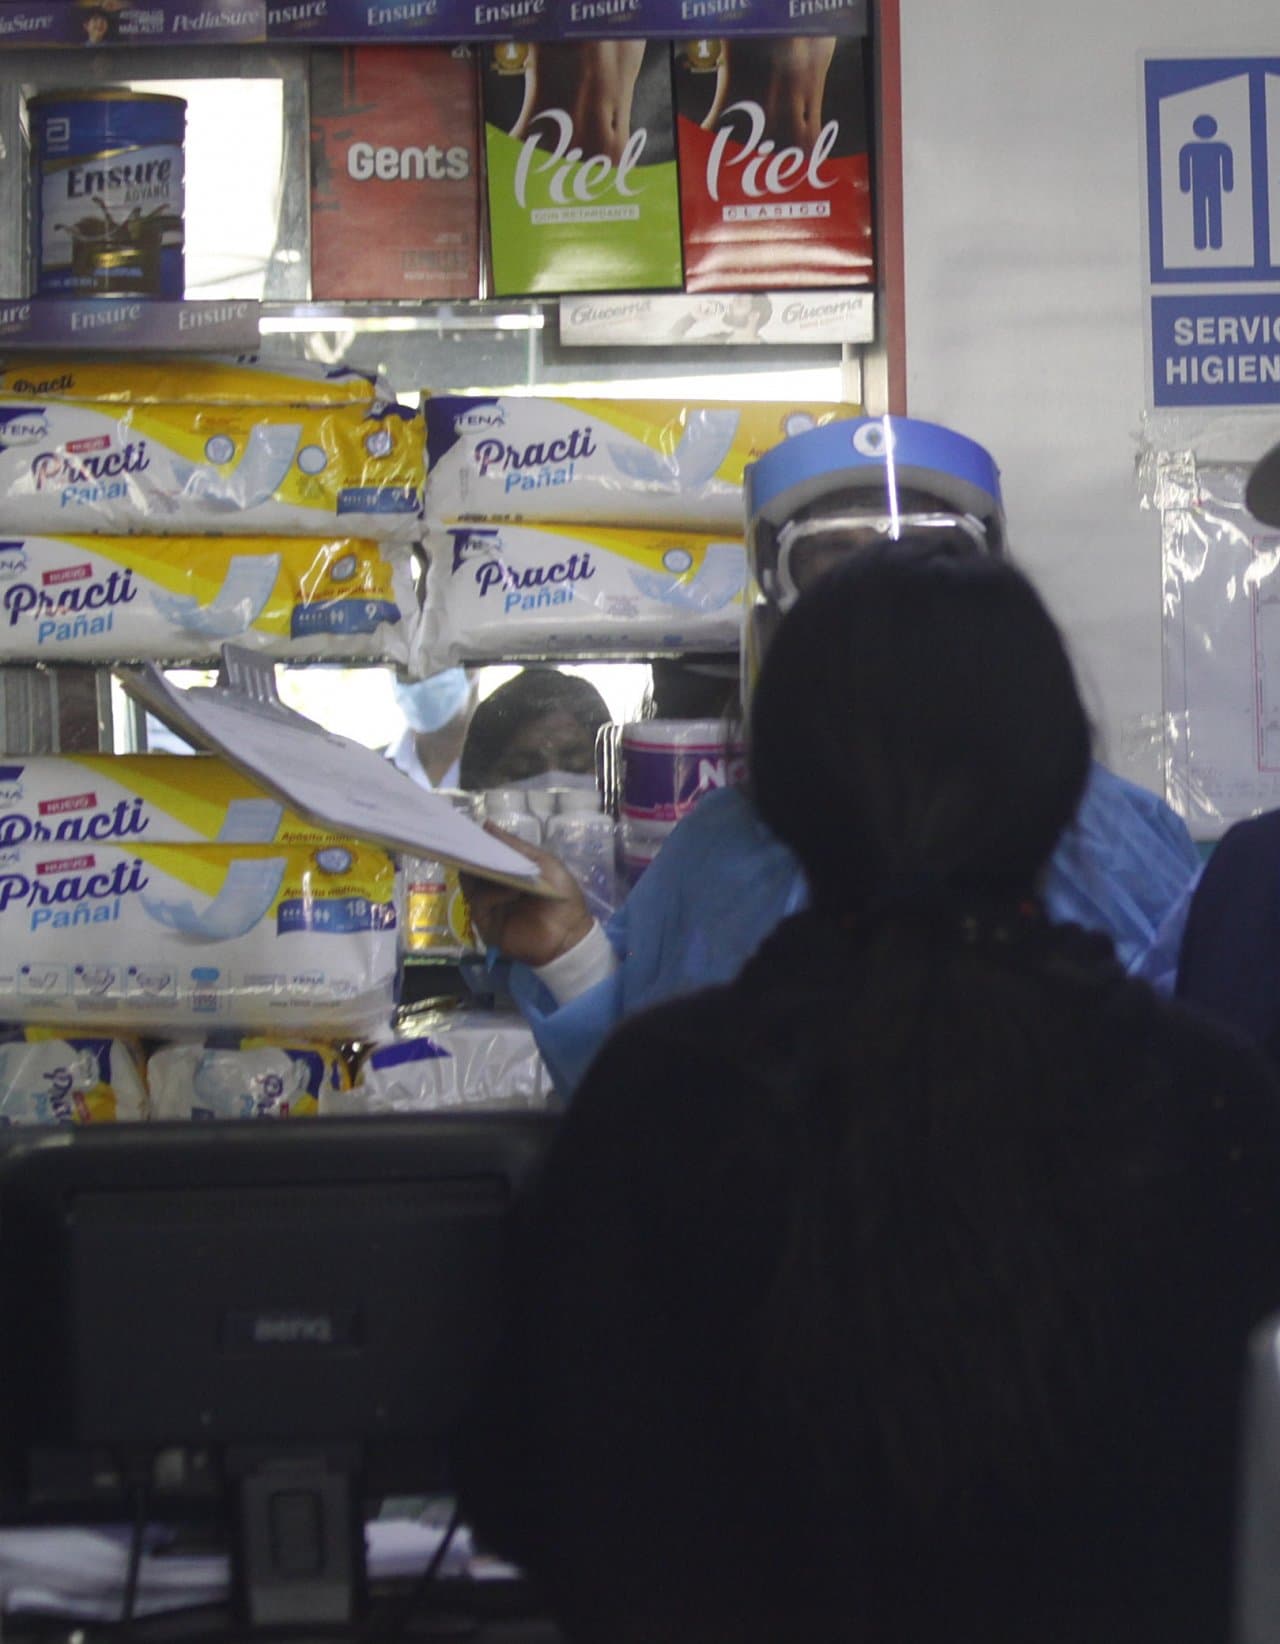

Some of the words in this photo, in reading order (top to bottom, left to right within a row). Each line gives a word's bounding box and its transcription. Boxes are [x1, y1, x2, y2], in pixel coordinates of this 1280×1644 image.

[367, 1, 438, 26] Ensure
[475, 0, 545, 25] Ensure
[570, 0, 642, 22] Ensure
[347, 141, 470, 181] Gents
[514, 108, 649, 209] Piel
[706, 100, 840, 202] Piel
[67, 158, 171, 199] Ensure
[71, 305, 141, 331] Ensure
[178, 304, 248, 331] Ensure
[781, 297, 864, 324] Glucerna
[13, 373, 75, 394] Practi
[31, 440, 150, 490] Practi
[475, 426, 597, 477] Practi
[505, 462, 574, 494] Pañal
[475, 552, 596, 598] Practi
[4, 567, 138, 626] Practi
[505, 582, 574, 614] Pañal
[38, 610, 113, 646] Pañal
[46, 797, 89, 813] NUEVO
[0, 797, 149, 850] Practi
[45, 859, 88, 873] NUEVO
[0, 858, 149, 912] Practi
[30, 897, 121, 932] Pañal
